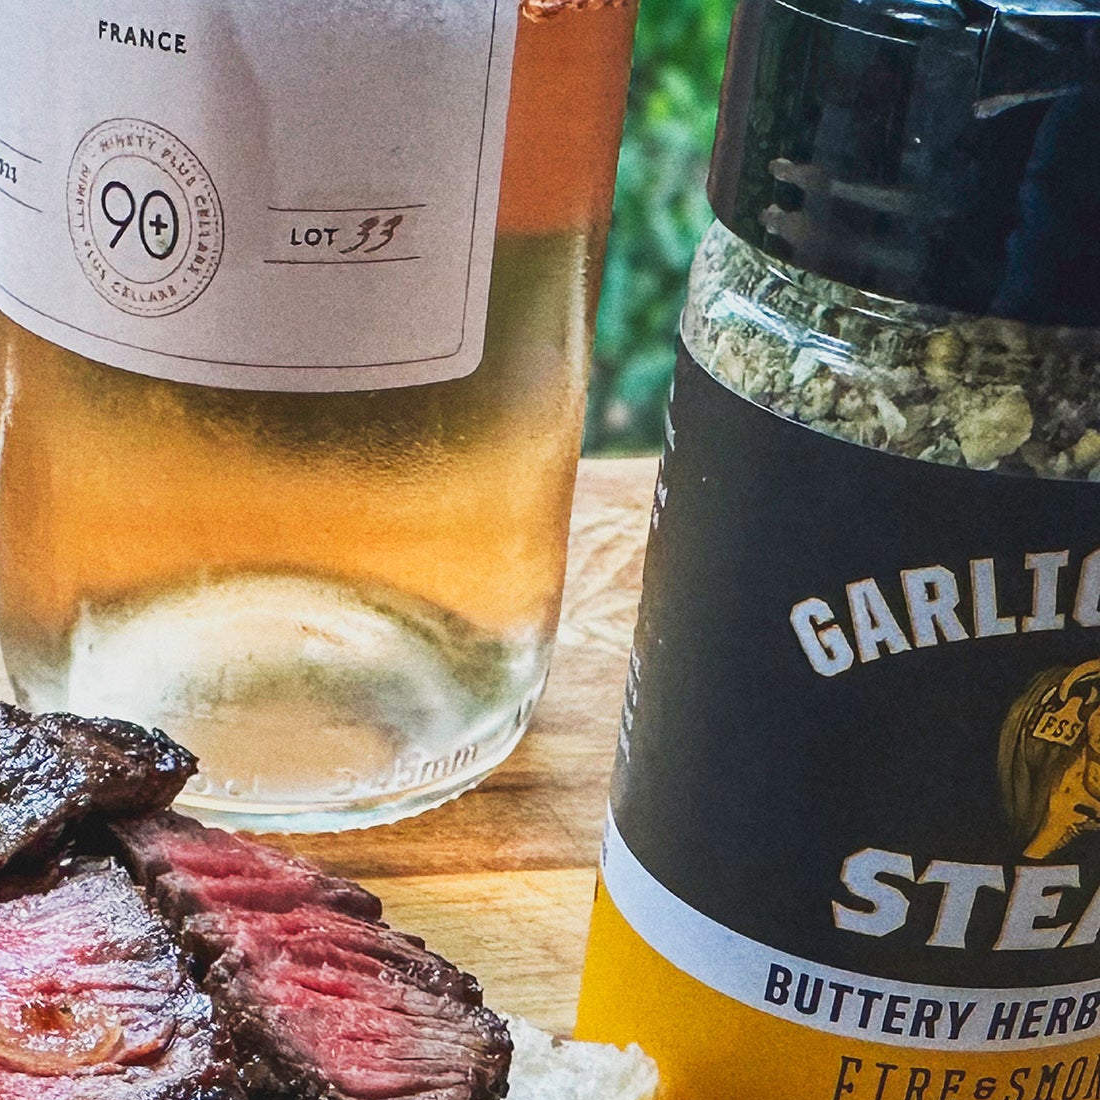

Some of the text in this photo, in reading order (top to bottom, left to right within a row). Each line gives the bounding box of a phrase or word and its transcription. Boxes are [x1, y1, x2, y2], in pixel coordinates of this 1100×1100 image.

[98, 19, 187, 55] FRANCE
[289, 214, 404, 255] LOT 33
[1040, 715, 1082, 741] FSS
[763, 962, 977, 1040] BUTTERY
